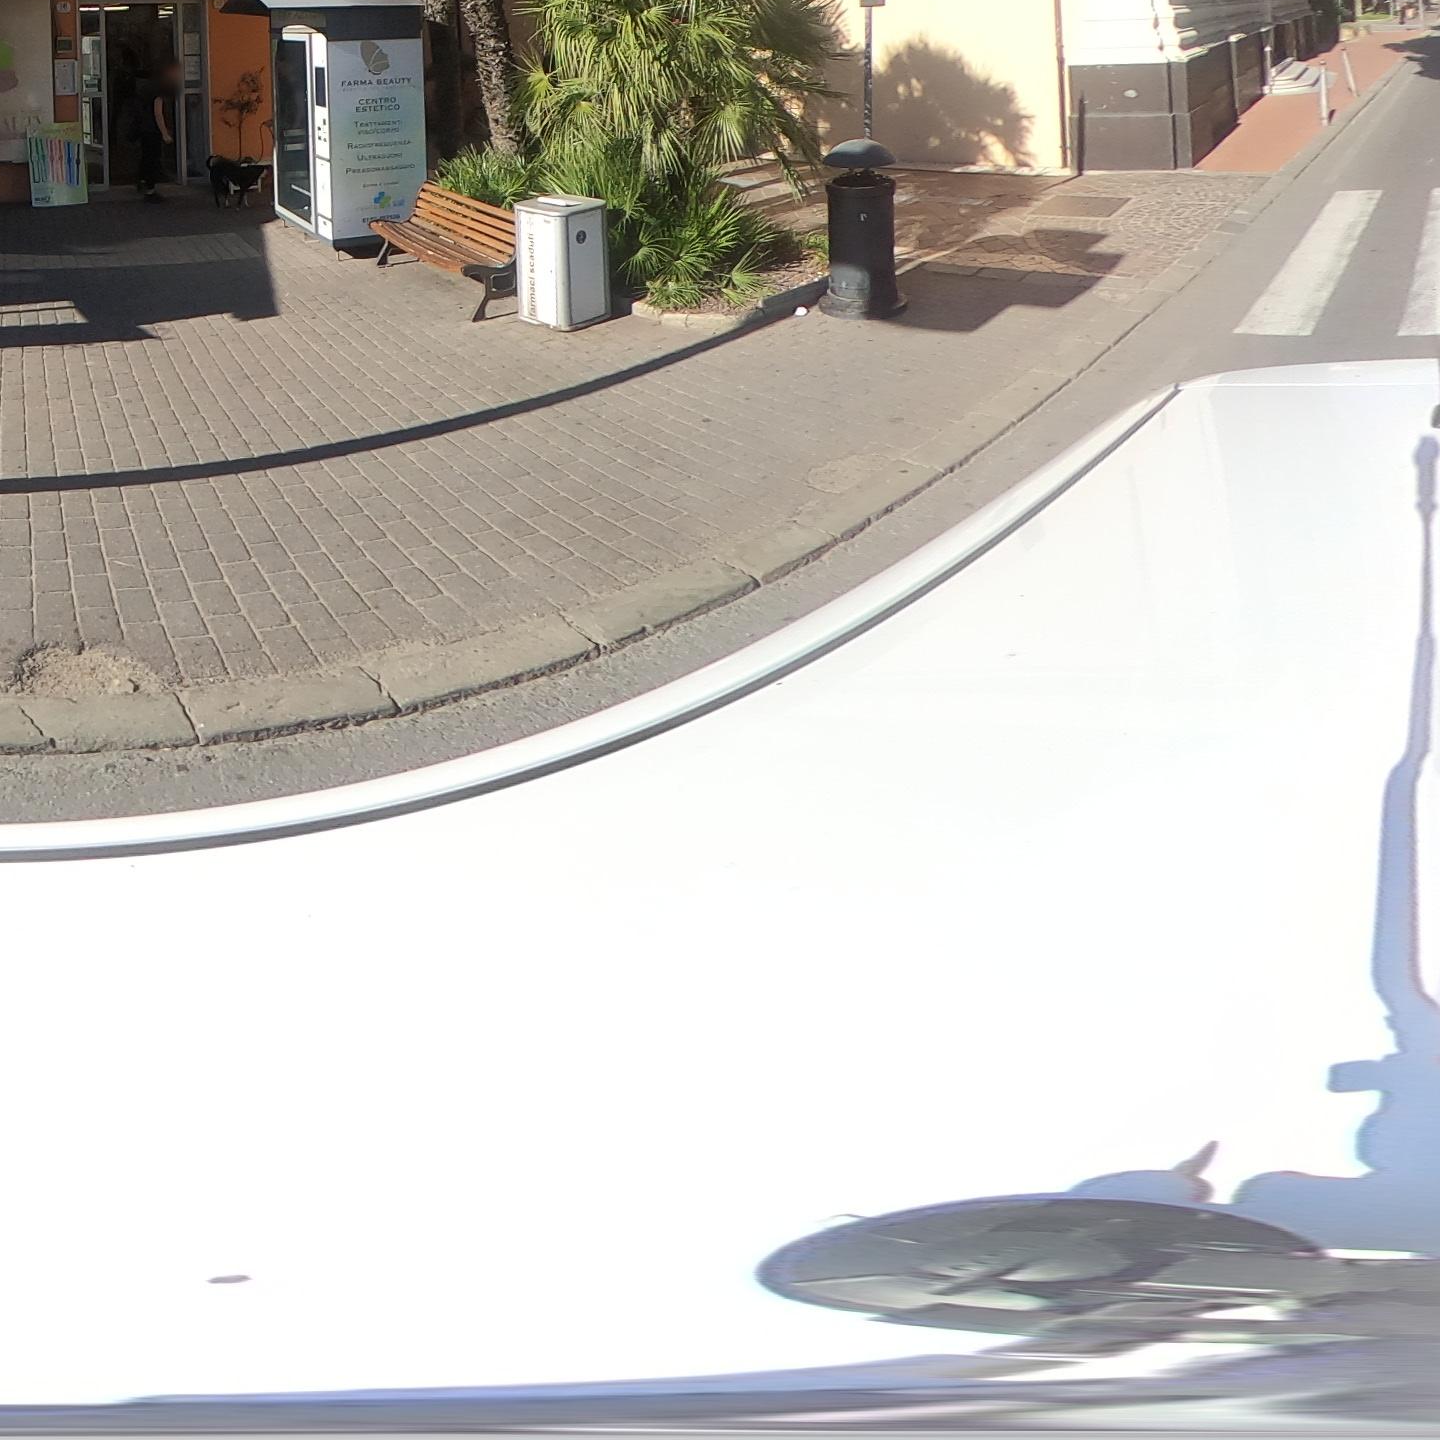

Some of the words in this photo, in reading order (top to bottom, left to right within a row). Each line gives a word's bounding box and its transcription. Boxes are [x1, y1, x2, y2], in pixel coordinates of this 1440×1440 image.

[341, 79, 373, 87] FARMA
[376, 77, 412, 85] BEAUTY
[358, 97, 396, 106] CENTRO
[355, 104, 400, 113] ESTETICO
[528, 277, 537, 317] farmaci
